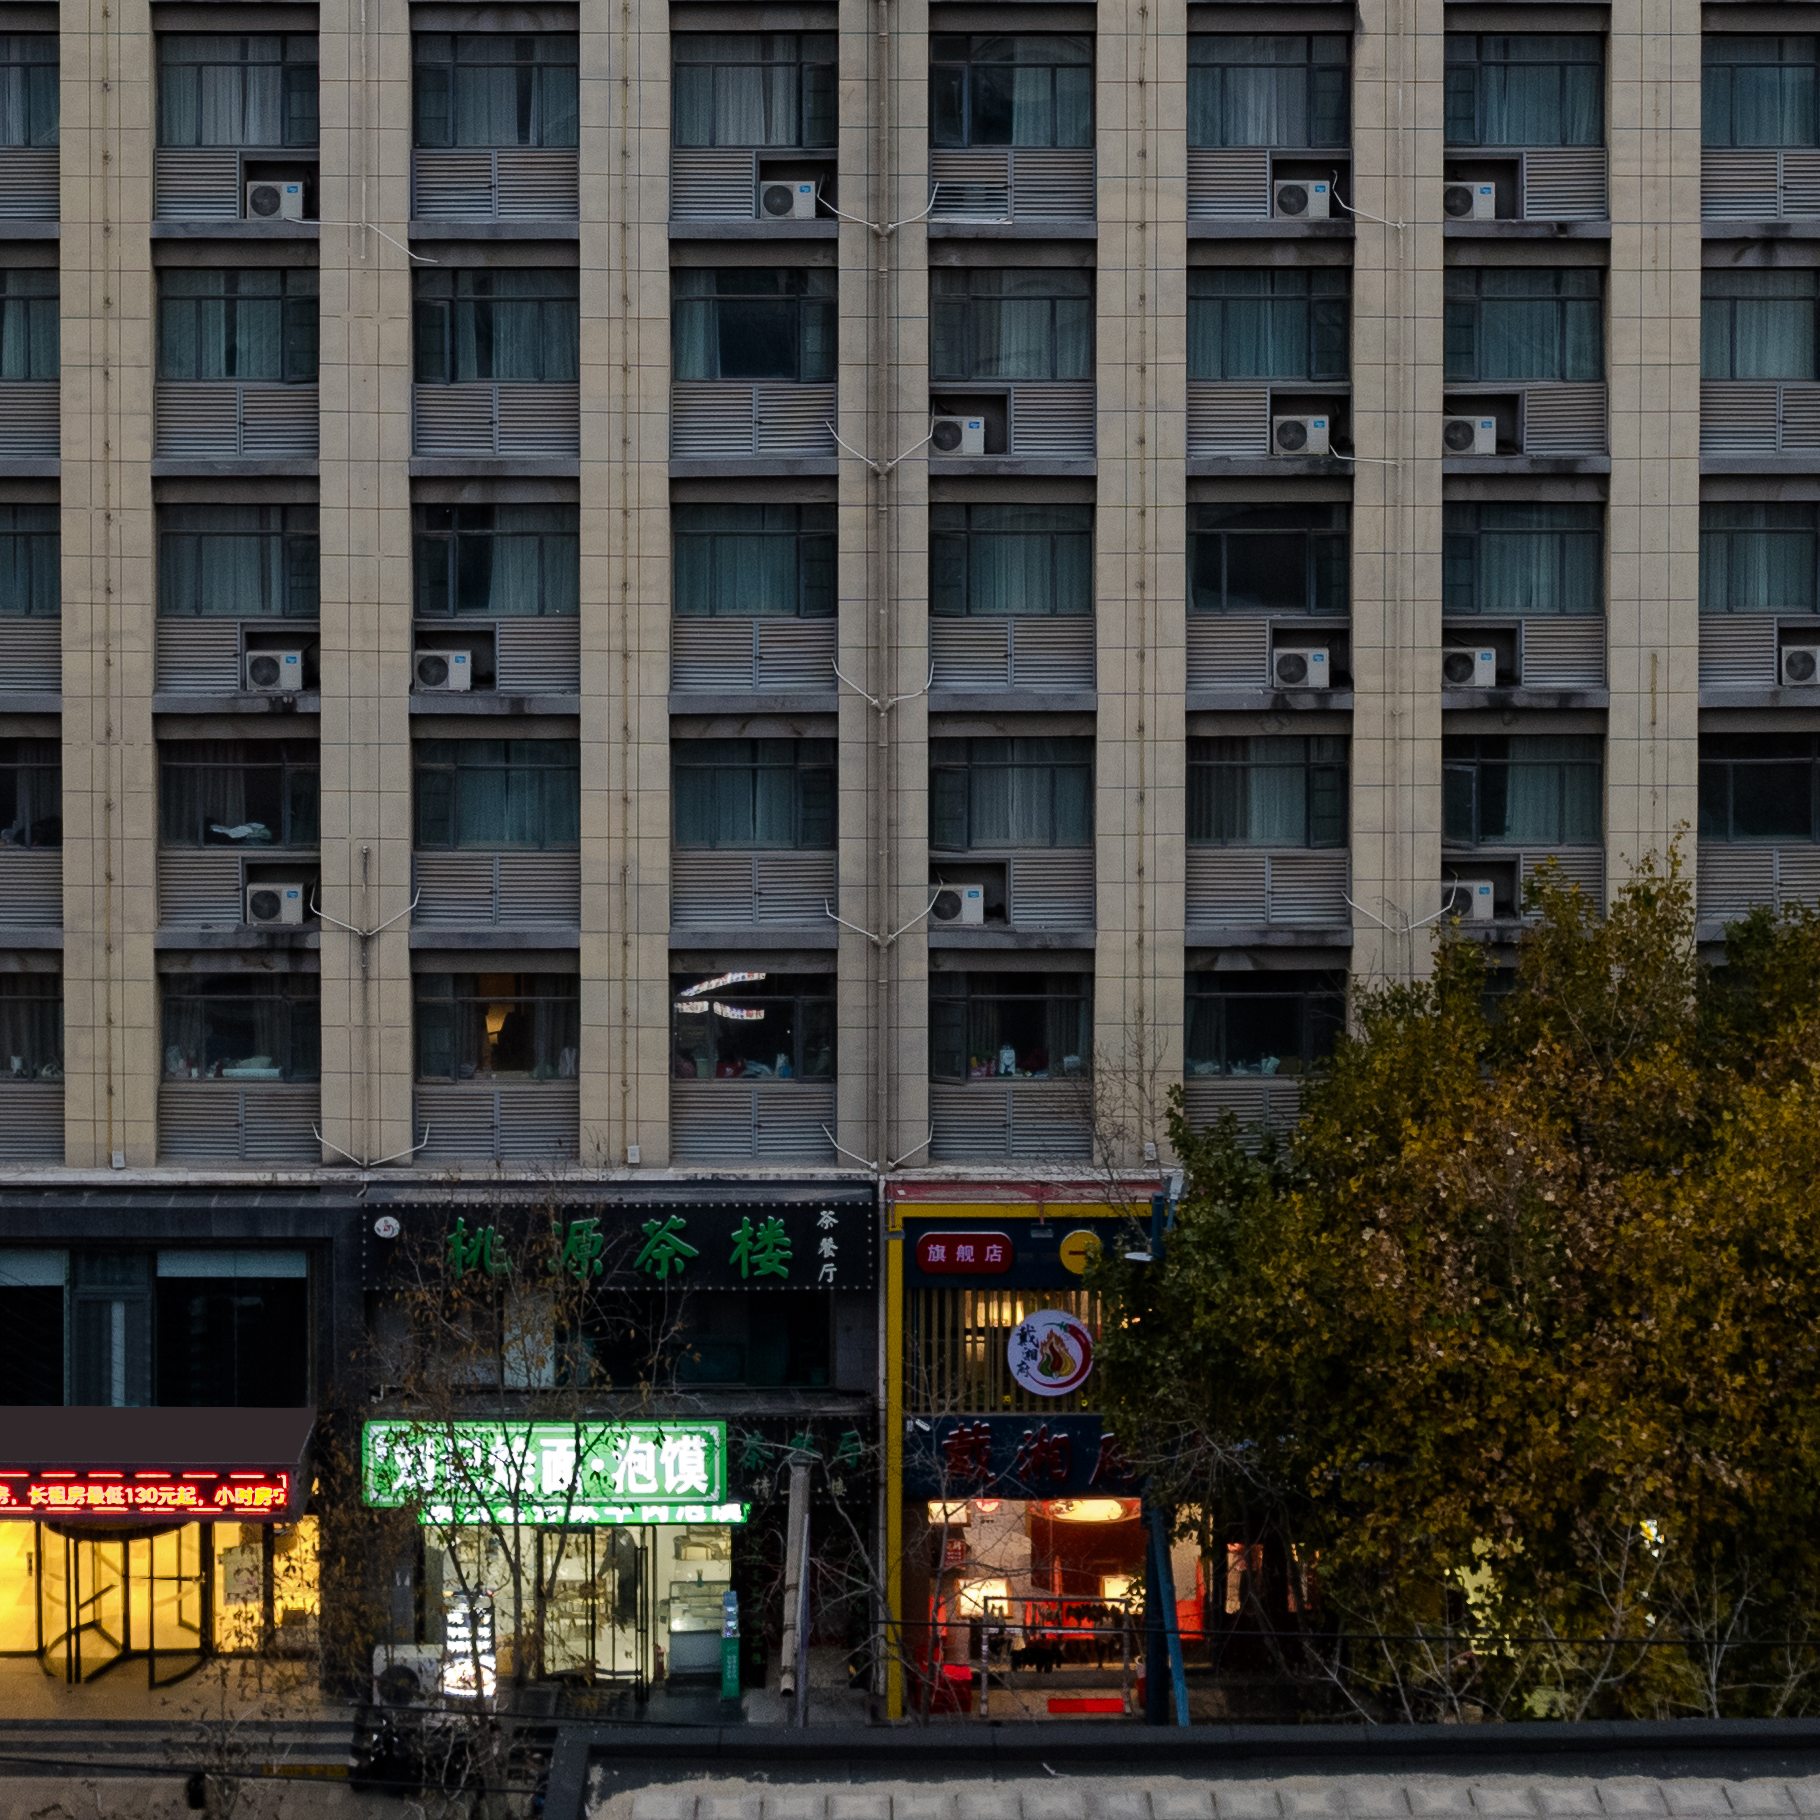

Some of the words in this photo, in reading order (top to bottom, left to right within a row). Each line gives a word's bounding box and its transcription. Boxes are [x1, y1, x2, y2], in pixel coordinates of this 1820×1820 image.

[445, 1214, 794, 1281] 桃源茶楼
[816, 1210, 840, 1284] 茶餐厅
[927, 1244, 1004, 1263] 旗舰店
